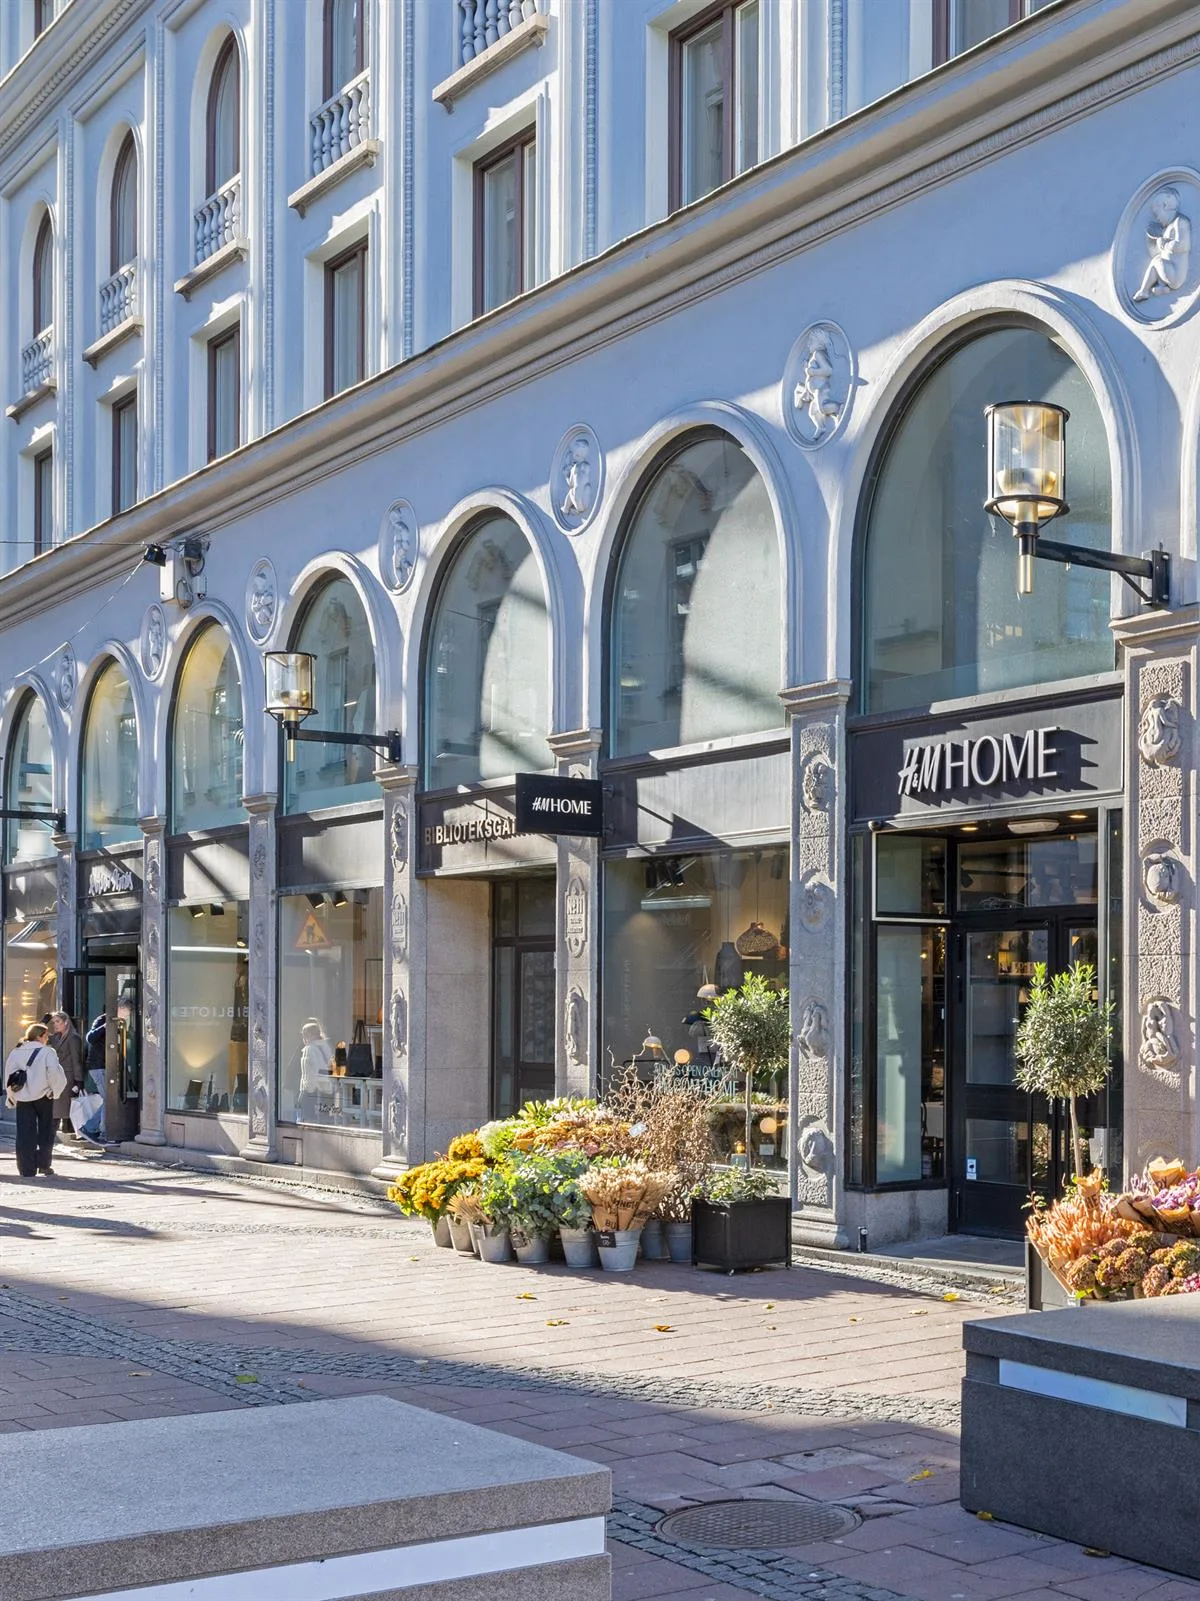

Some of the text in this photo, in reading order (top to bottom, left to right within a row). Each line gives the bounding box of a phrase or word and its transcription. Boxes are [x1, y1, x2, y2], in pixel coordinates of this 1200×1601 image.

[898, 726, 1058, 795] H&M HOME
[550, 798, 592, 815] HOME
[424, 818, 516, 845] BIBLIOTEKSGAT
